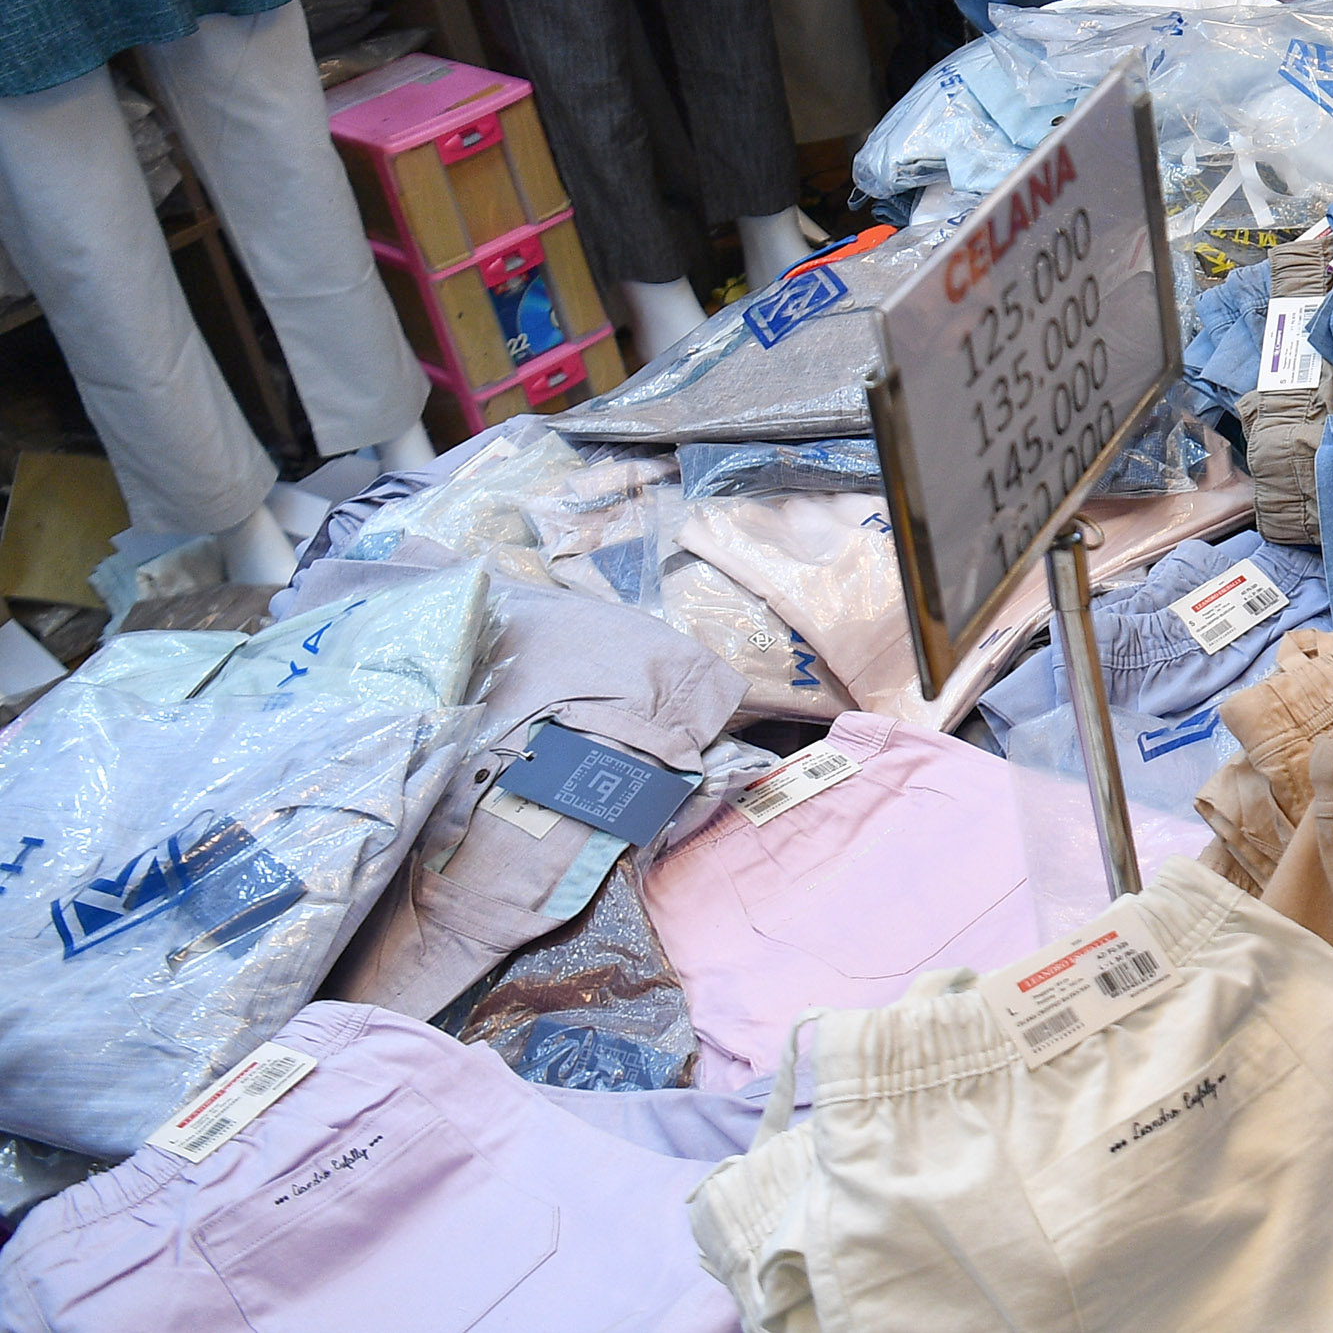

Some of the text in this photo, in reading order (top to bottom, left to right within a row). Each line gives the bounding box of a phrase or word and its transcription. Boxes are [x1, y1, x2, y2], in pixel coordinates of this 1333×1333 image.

[942, 144, 1079, 305] CELANA
[957, 207, 1093, 388] 125.000
[971, 273, 1101, 457] 135.000
[983, 337, 1109, 514] 145.000
[1025, 960, 1069, 989] LEANDRO
